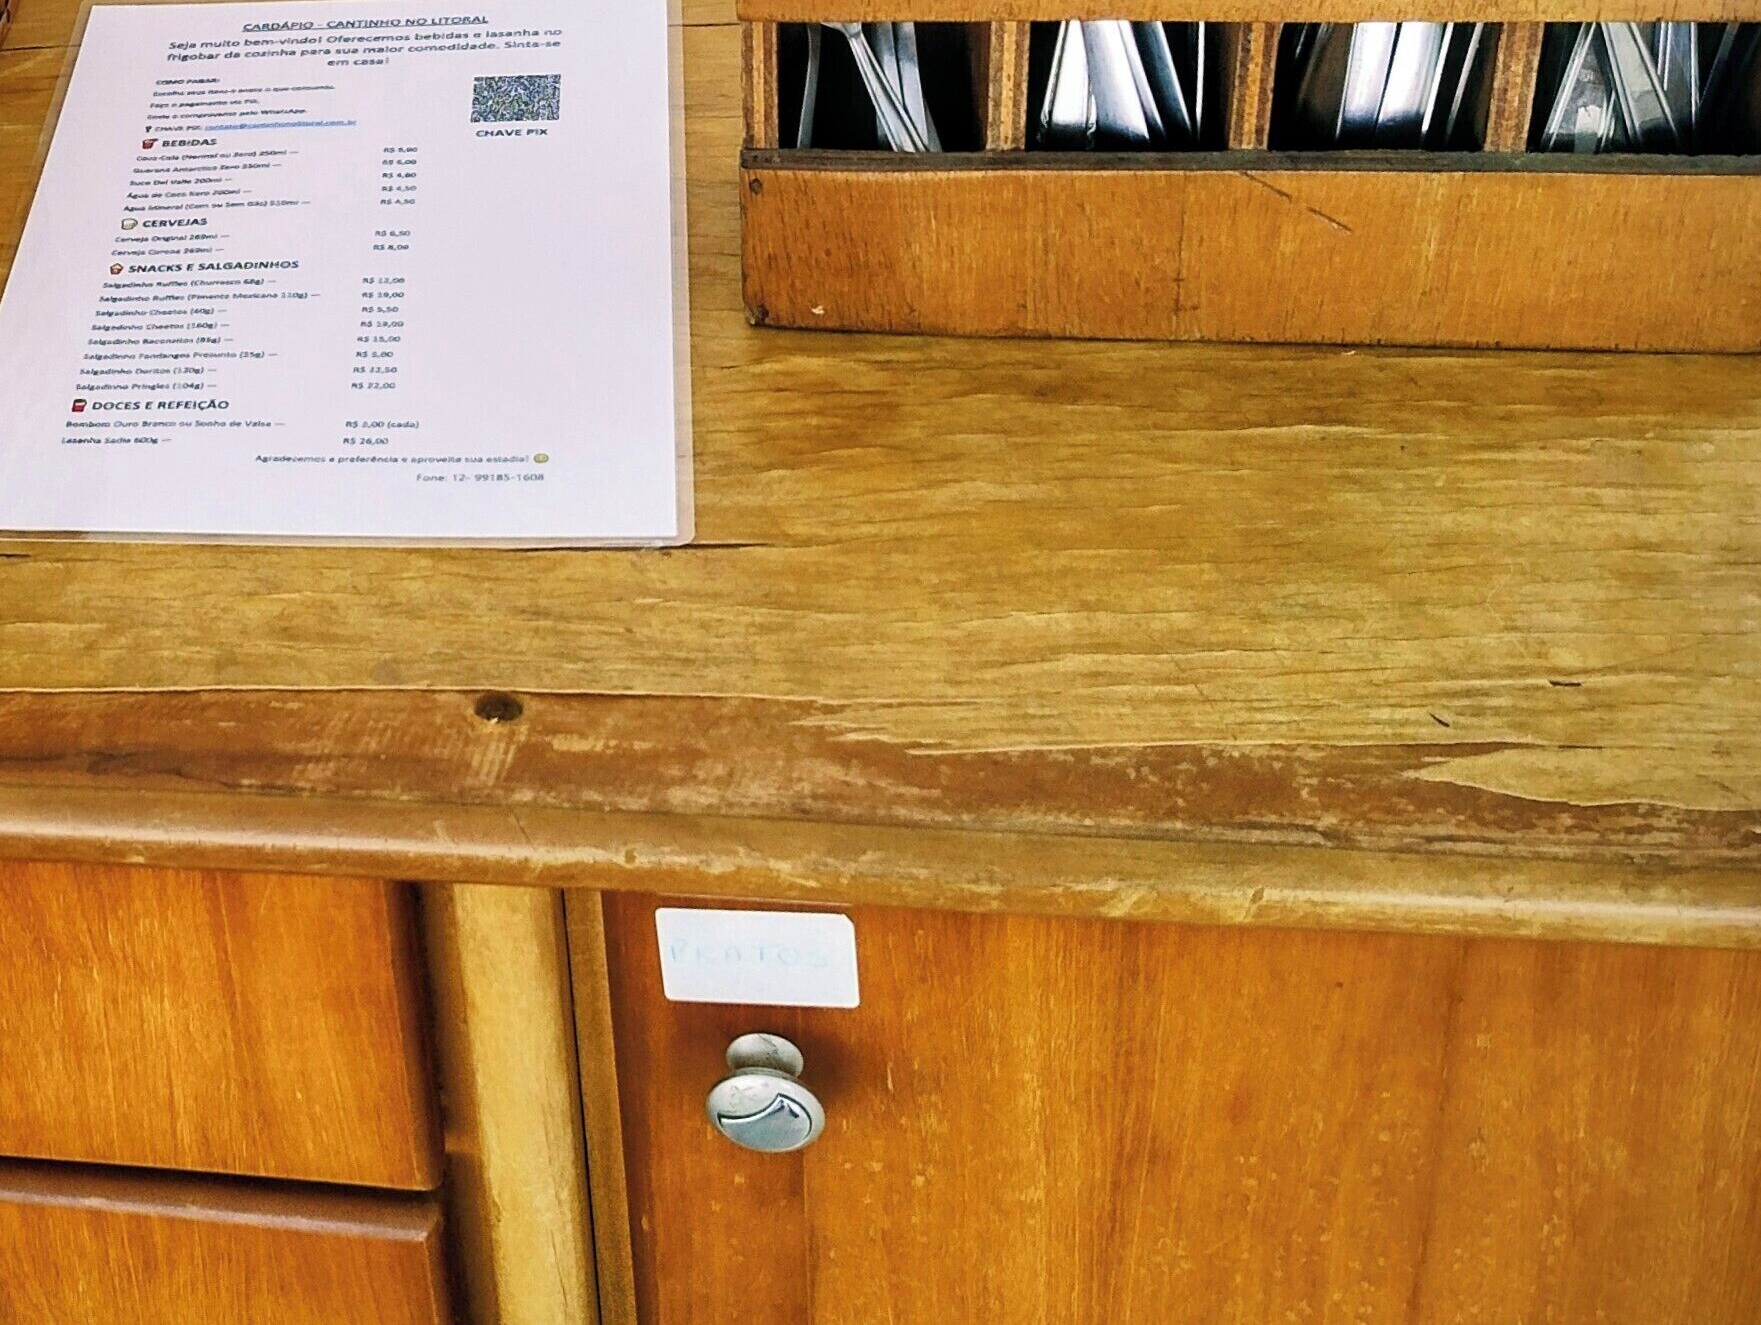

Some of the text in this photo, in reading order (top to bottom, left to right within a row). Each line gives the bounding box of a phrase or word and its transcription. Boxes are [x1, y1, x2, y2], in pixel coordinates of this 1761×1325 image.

[243, 20, 313, 32] CARDÁPIO
[327, 18, 400, 29] CANTINHO
[406, 18, 427, 26] NO
[432, 15, 489, 25] LITORAL
[169, 42, 196, 50] Seja
[200, 40, 240, 48] muito
[244, 36, 322, 46] bem-vindo!
[326, 35, 410, 43] Oferecemos
[415, 32, 469, 40] bebidas
[486, 29, 539, 38] lasanha
[167, 49, 220, 62] frigobar
[244, 49, 296, 58] cozinha
[300, 49, 331, 57] para
[408, 42, 499, 52] comodidade.
[353, 57, 389, 65] casa!
[476, 129, 521, 137] CHAVE
[162, 139, 217, 147] BEBIDAS
[143, 218, 207, 228] CERVEJAS
[128, 264, 182, 273] SNACKS
[198, 261, 299, 270] SALGADINHOS
[80, 368, 132, 376] Salgadinho
[92, 402, 140, 410] DOCES
[157, 399, 229, 411] REFEIÇÃO
[255, 455, 325, 463] Agradecemos
[338, 456, 398, 464] preferência
